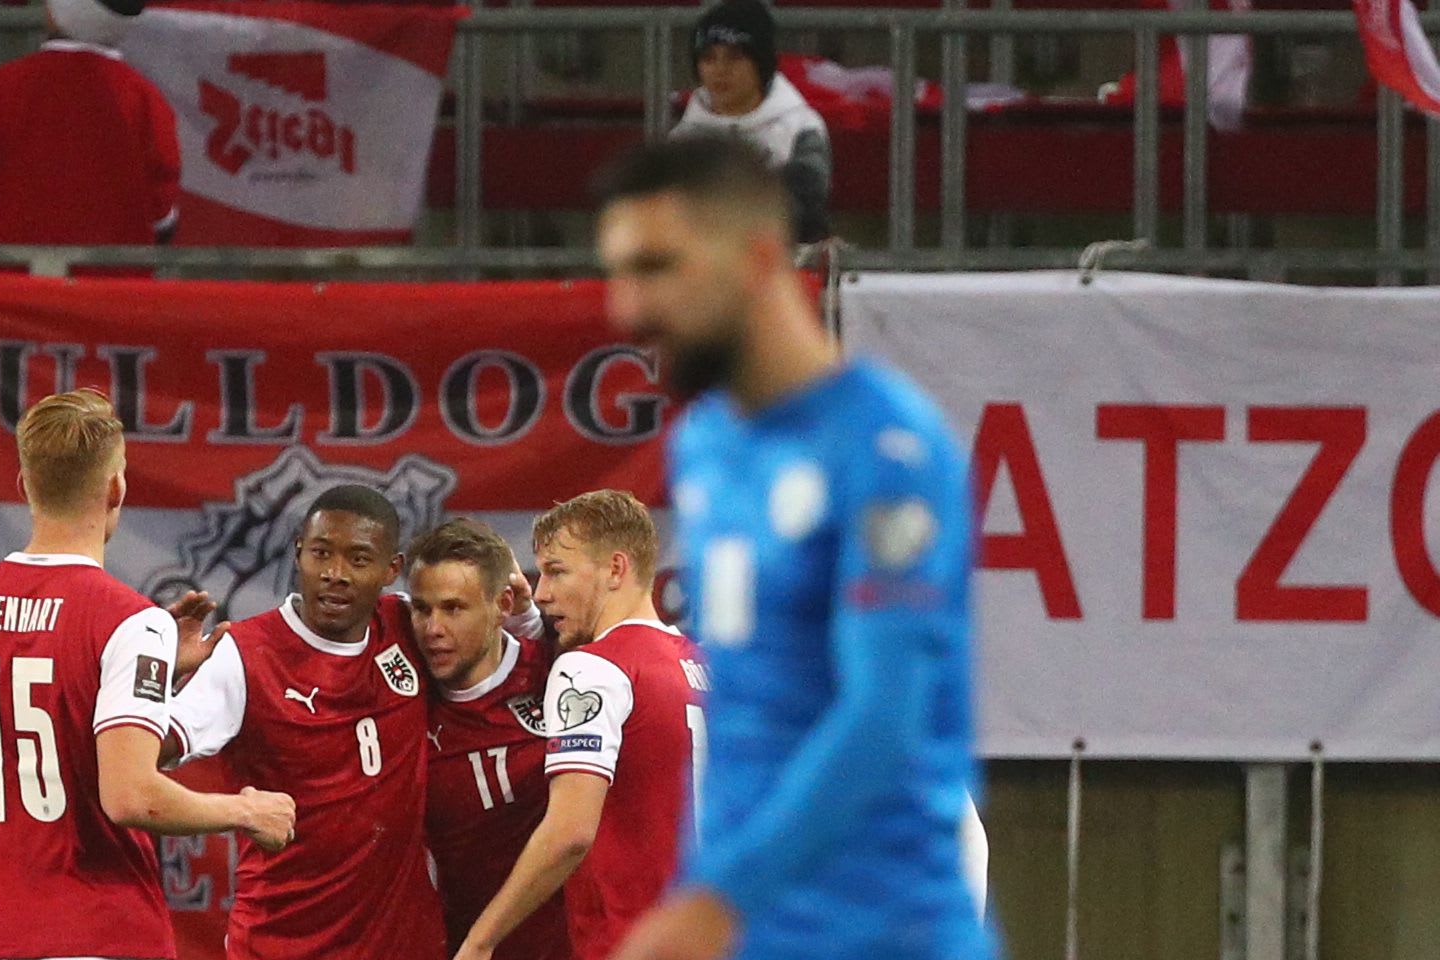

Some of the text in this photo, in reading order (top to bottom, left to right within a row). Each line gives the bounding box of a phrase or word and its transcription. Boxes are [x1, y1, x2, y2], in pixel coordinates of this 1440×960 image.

[356, 717, 382, 776] 8
[561, 738, 601, 748] RESPECT
[468, 746, 514, 810] 17
